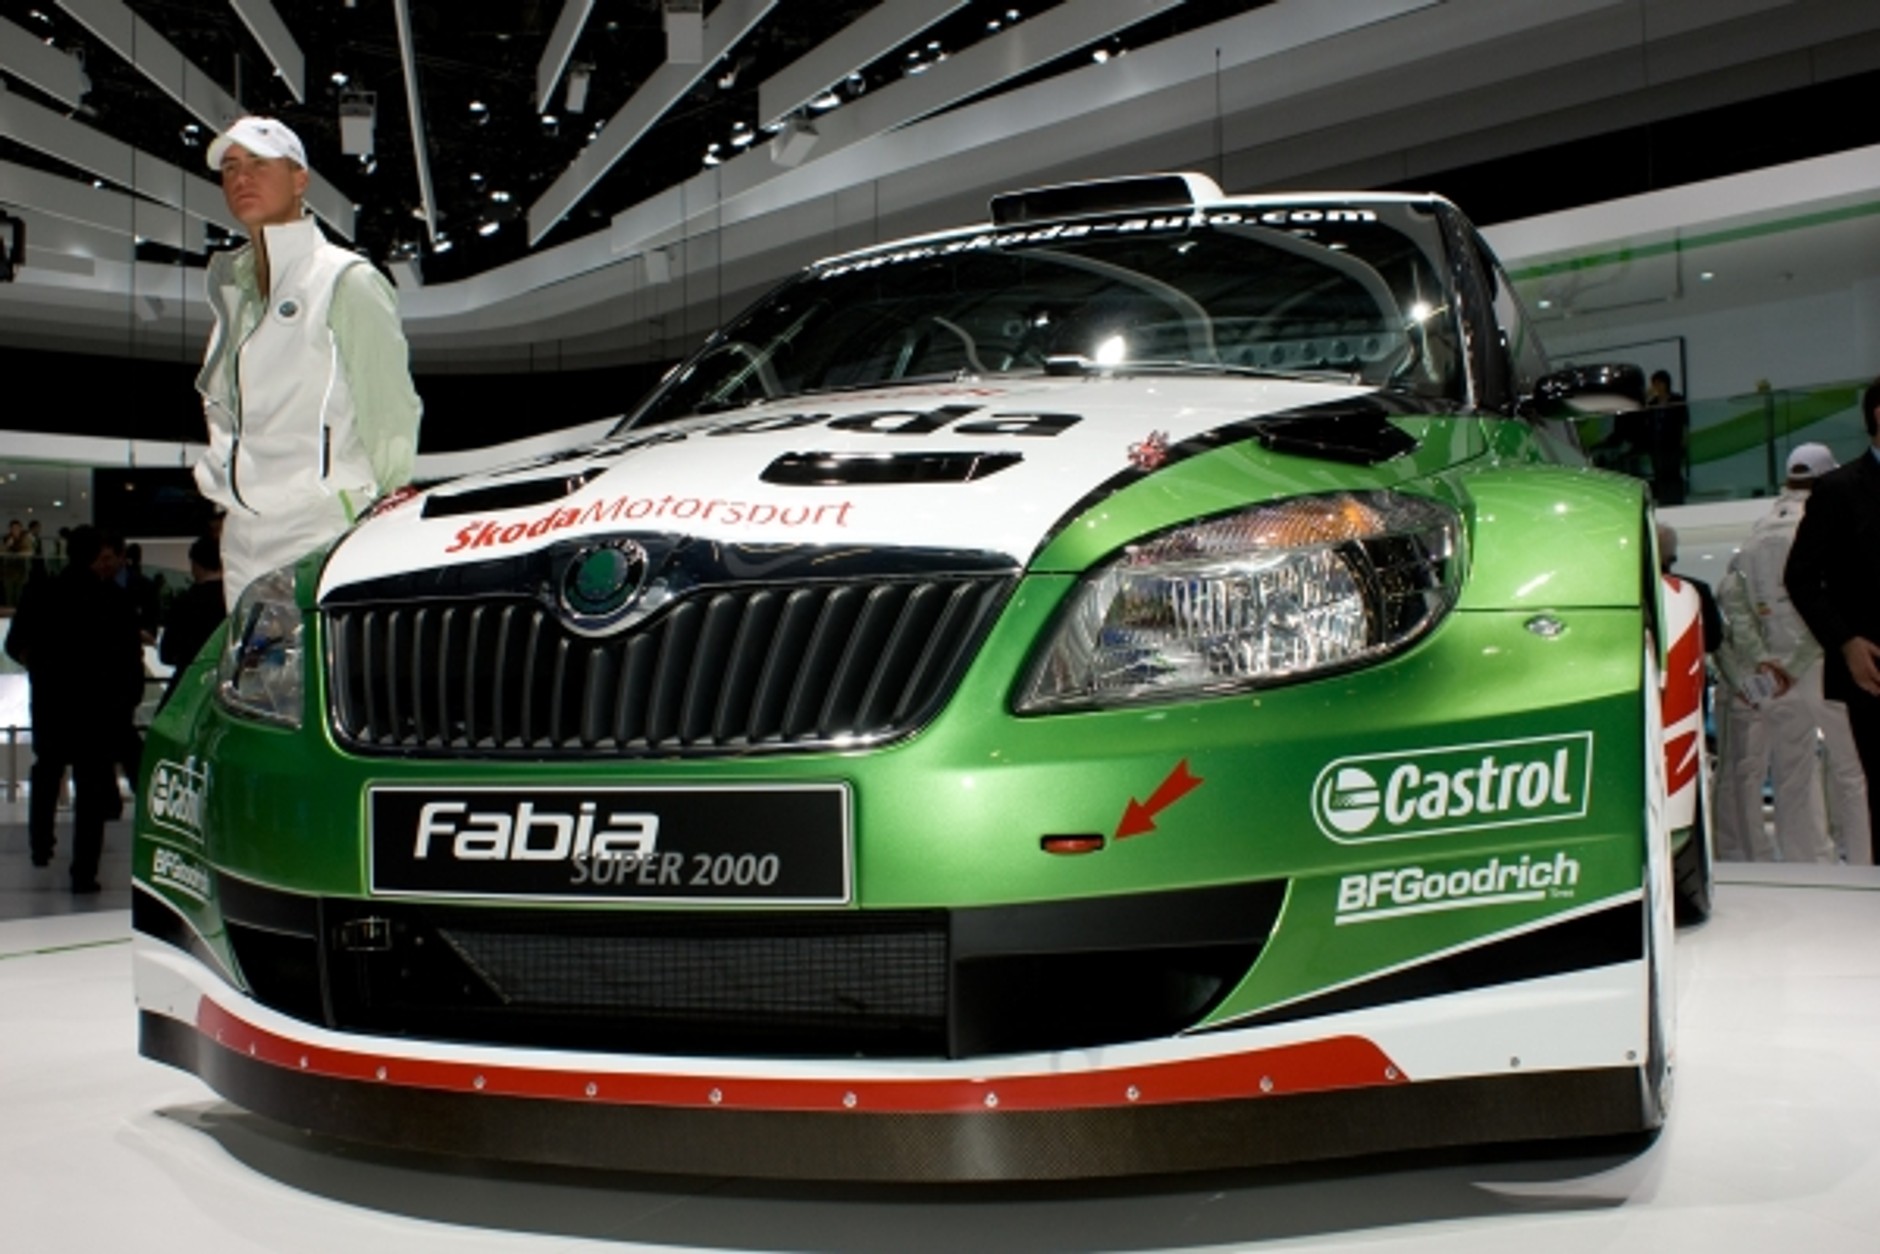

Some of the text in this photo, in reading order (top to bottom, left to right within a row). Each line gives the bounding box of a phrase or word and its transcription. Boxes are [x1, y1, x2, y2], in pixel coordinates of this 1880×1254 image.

[1384, 747, 1572, 825] Castrol
[413, 802, 660, 861] Fabia
[570, 851, 781, 886] SUPER 2000
[1336, 851, 1581, 913] BFGoodrich
